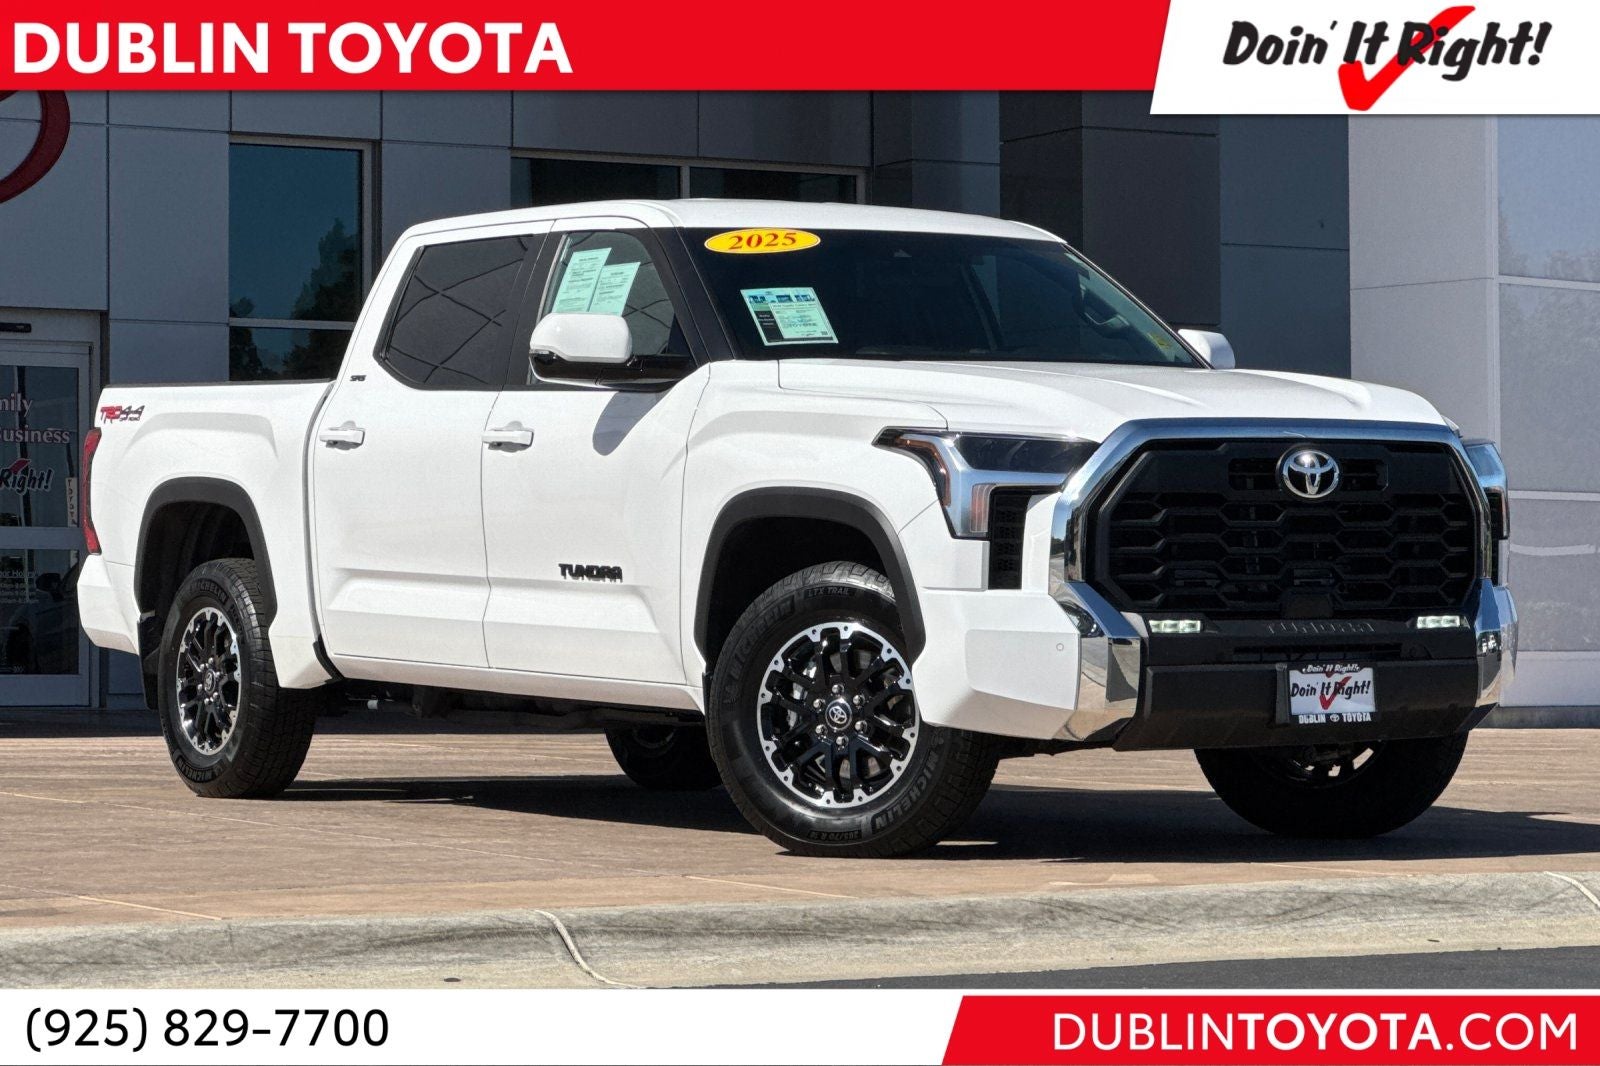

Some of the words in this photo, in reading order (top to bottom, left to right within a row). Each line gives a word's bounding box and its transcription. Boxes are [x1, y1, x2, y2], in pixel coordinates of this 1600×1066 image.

[728, 232, 797, 250] 2025
[558, 563, 623, 581] TUNDRA
[1321, 681, 1332, 696] It
[1334, 680, 1372, 700] Right!
[1298, 713, 1327, 724] DUBLIN
[1341, 712, 1372, 723] TOYOTA
[875, 750, 939, 831] MICHELIN
